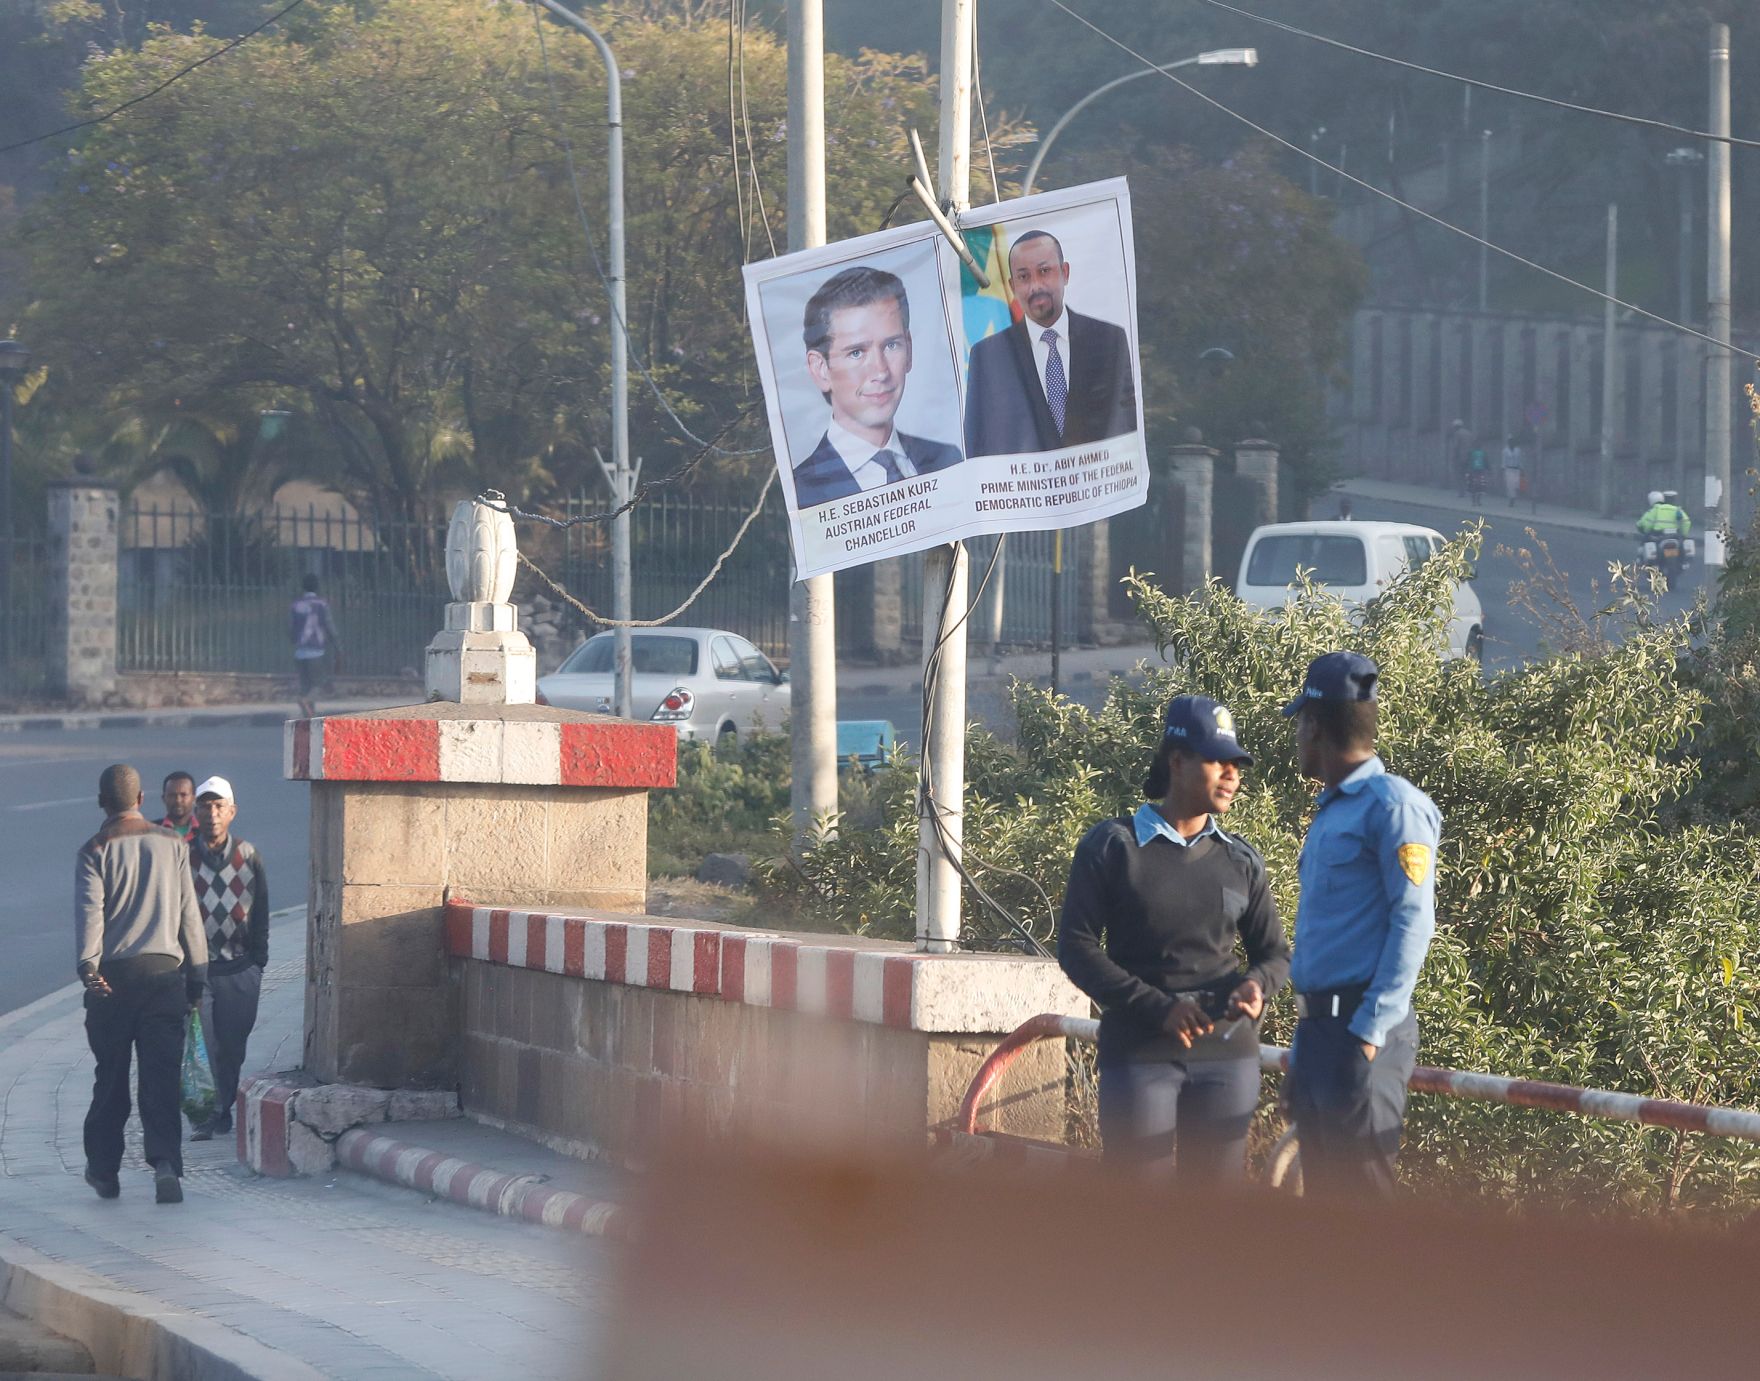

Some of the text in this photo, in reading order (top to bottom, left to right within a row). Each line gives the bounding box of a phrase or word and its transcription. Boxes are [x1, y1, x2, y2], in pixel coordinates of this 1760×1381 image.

[981, 460, 1134, 494] PRIME MINISTER OF THE FEDERAL
[1010, 463, 1031, 475] H.E.
[1055, 456, 1075, 471] ABIY
[819, 479, 938, 522] H.E. SEBASTIAN KURZ
[976, 476, 1137, 512] DEMOCRATIC REPUBLIC OF ETHIOPIA
[825, 498, 931, 539] AUSTRIAN FEDERAL
[845, 520, 916, 551] CHANCELLOR
